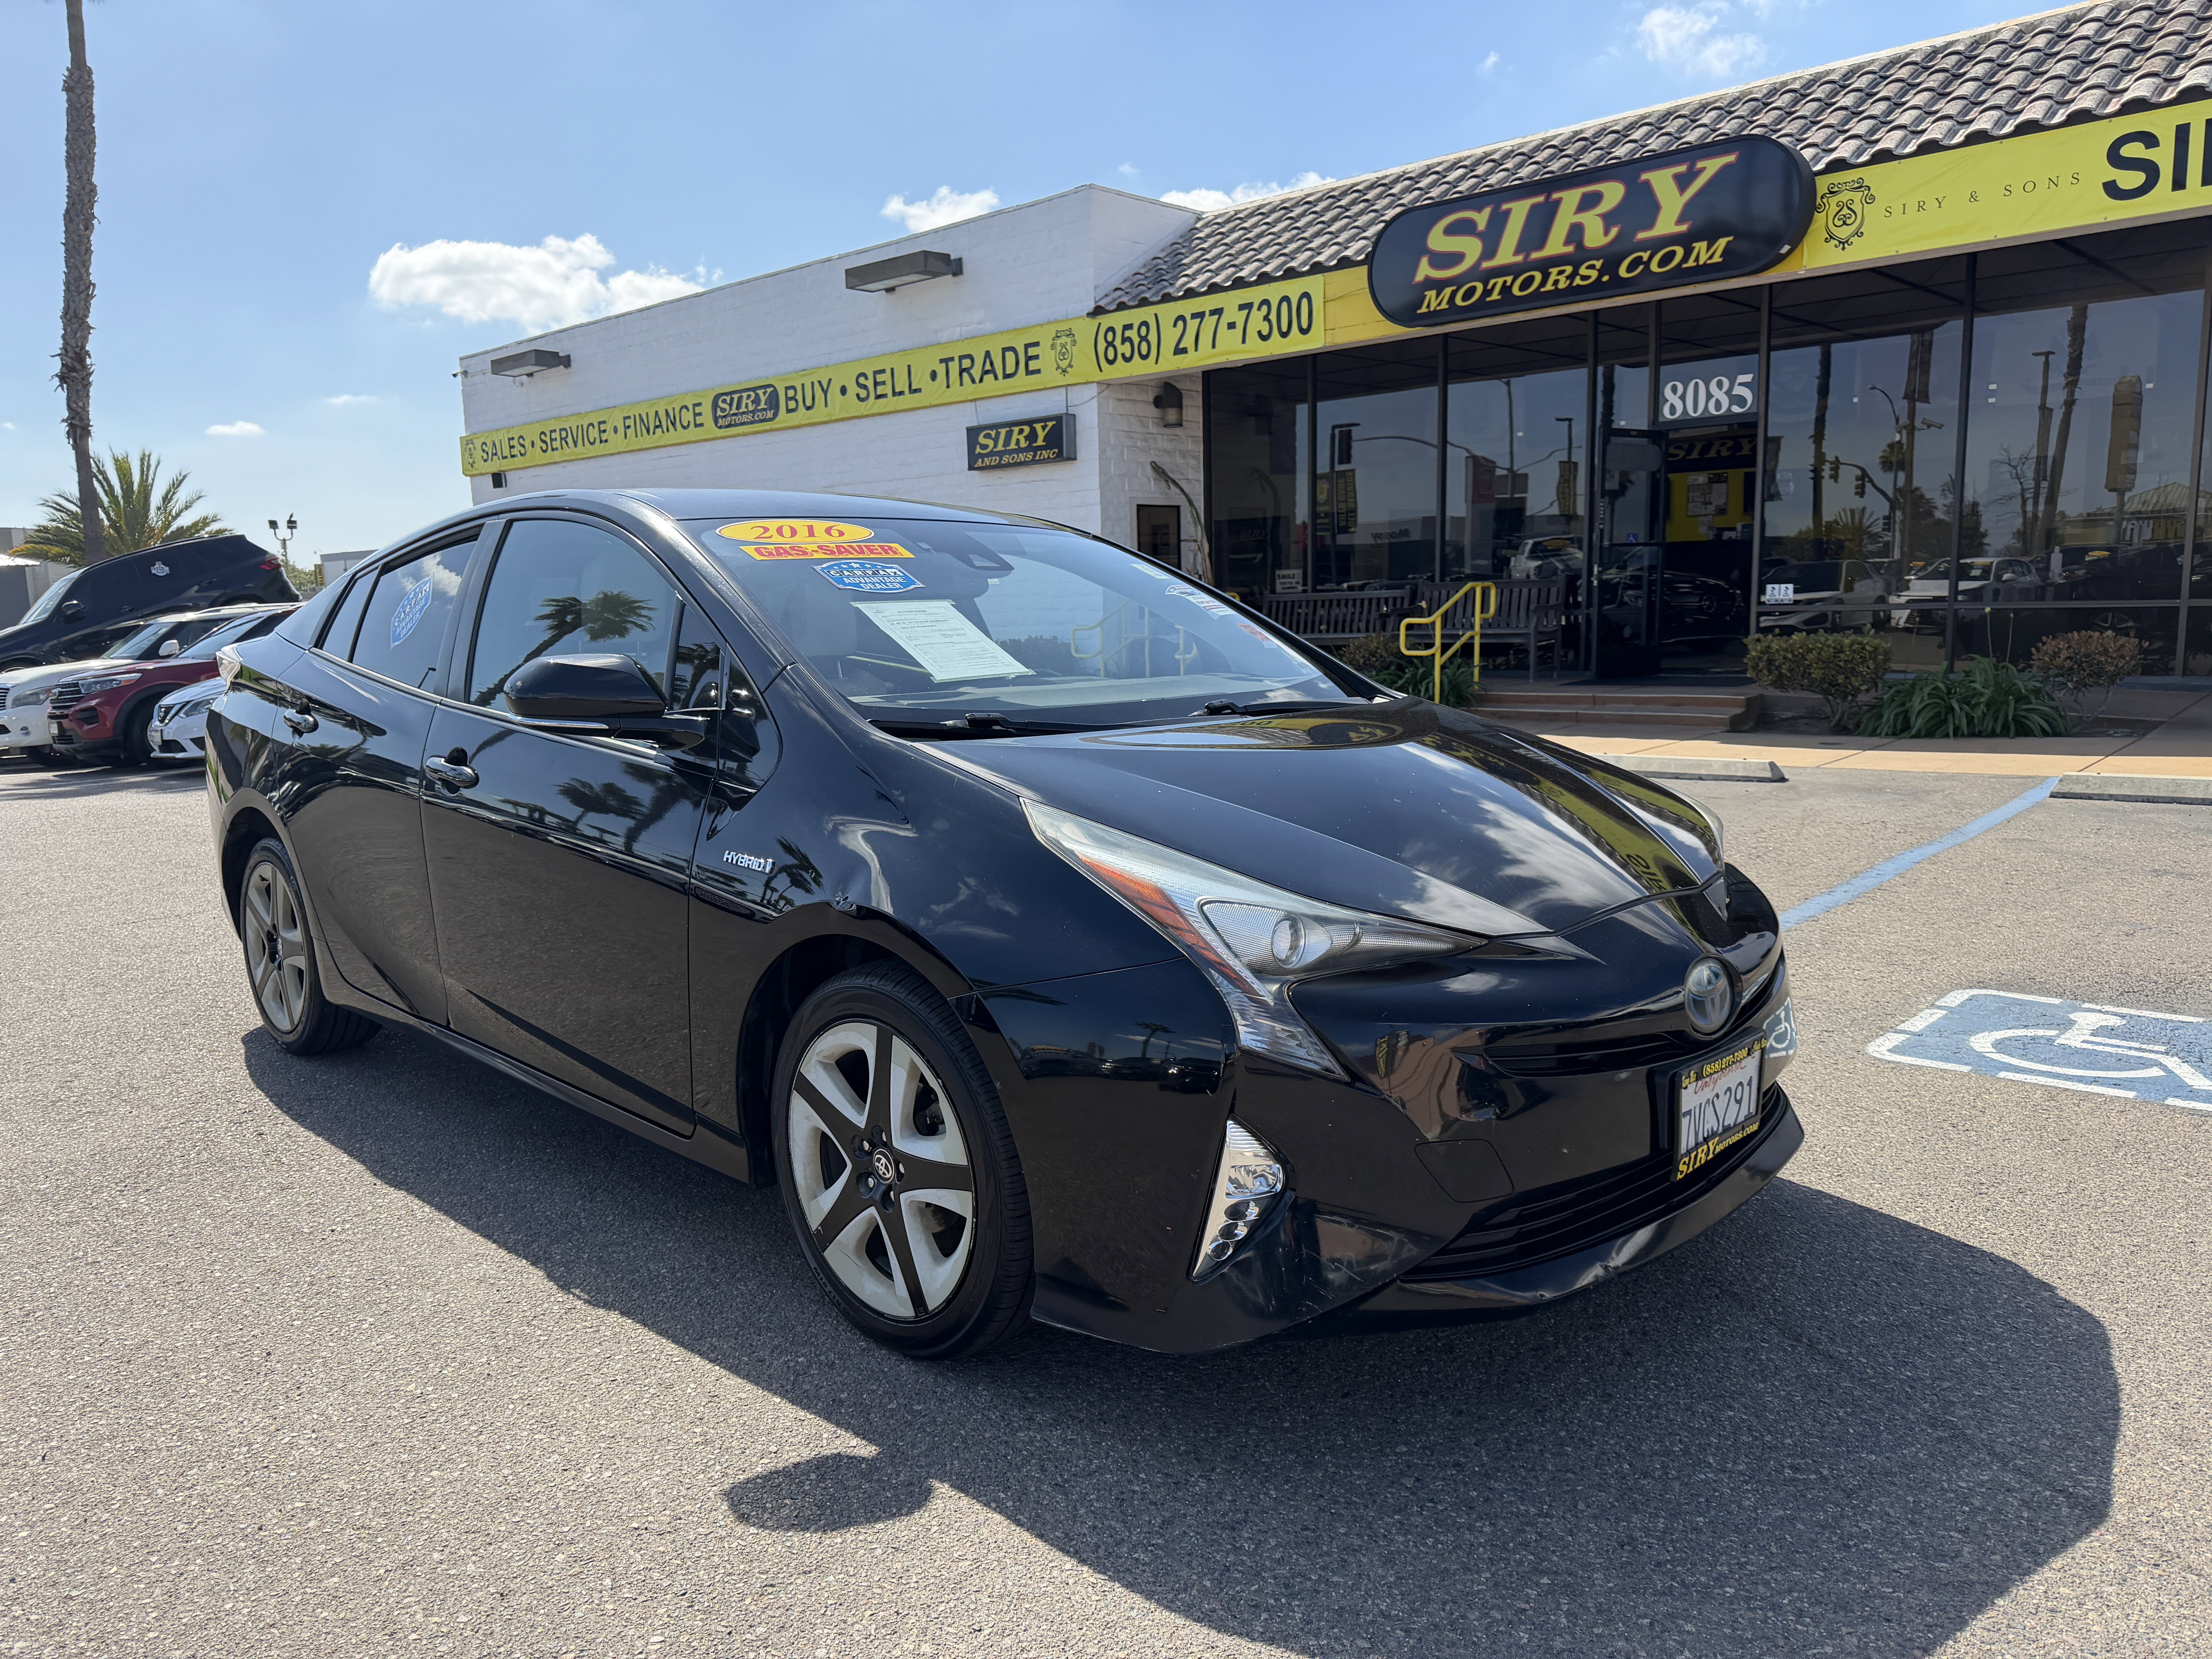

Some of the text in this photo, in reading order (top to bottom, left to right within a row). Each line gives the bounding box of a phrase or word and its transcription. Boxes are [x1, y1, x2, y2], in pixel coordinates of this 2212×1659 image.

[2102, 118, 2212, 201] SI
[1884, 172, 2081, 218] SIRY & SONS
[1412, 151, 1740, 284] SIRY
[1417, 236, 1734, 314] MOTORS.COM
[1094, 292, 1313, 373] (858) 277-7300
[785, 341, 1041, 414] BUY SELL TRADE
[1662, 374, 1754, 419] 8085
[716, 388, 774, 417] SIRY
[718, 410, 775, 426] MOTORS.COM
[481, 402, 704, 462] SALES SERVICE FINANCE
[975, 421, 1056, 453] SIRY
[1668, 438, 1757, 461] SIRY
[974, 449, 1058, 467] AND SONS INC
[750, 524, 846, 539] 2016
[754, 544, 899, 558] GAS-SAVER
[395, 582, 429, 627] CARFAX
[396, 597, 426, 635] ADVANTAGE
[401, 611, 420, 638] DEALER
[723, 850, 765, 871] HYBRID
